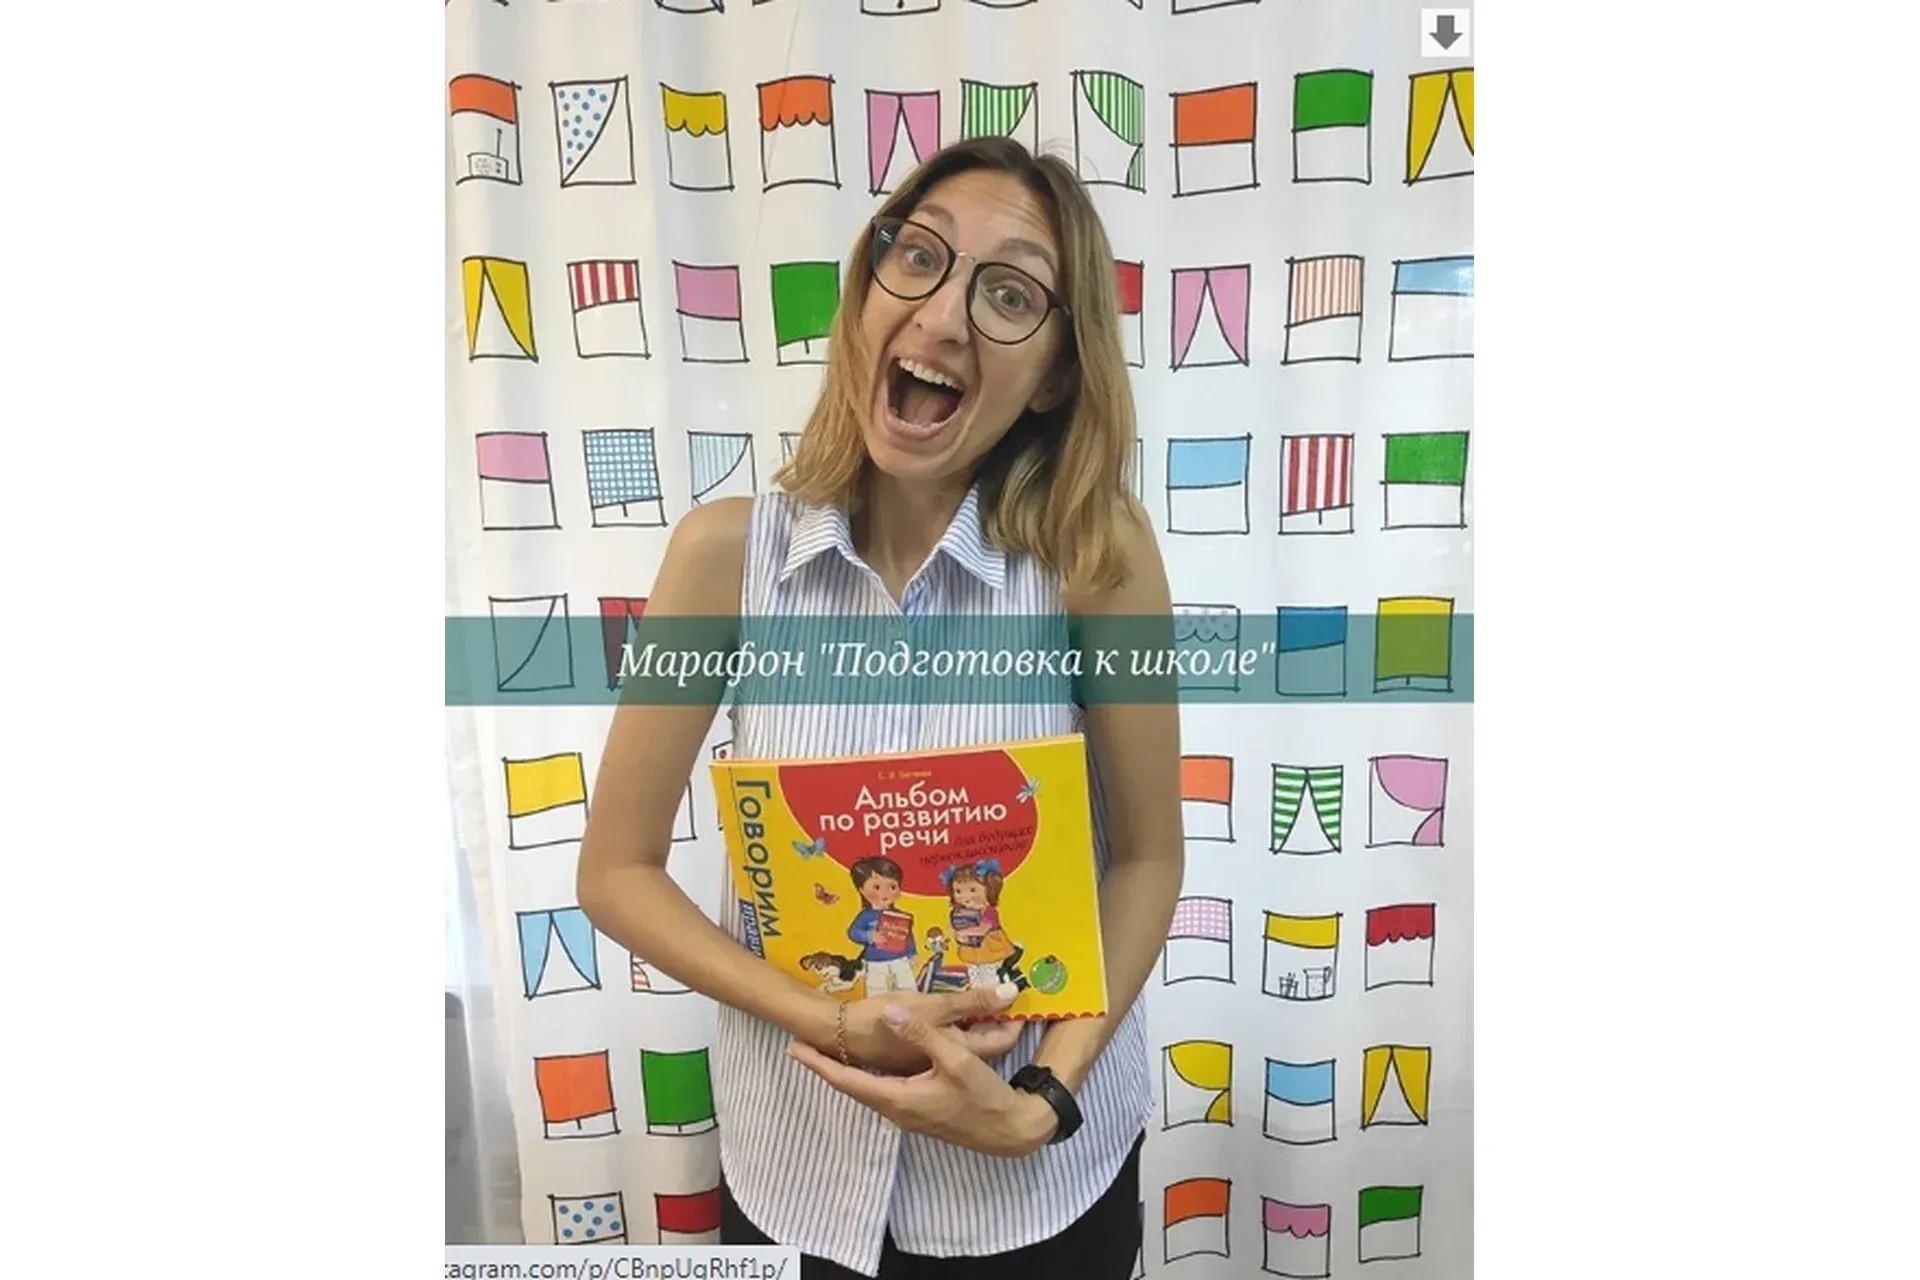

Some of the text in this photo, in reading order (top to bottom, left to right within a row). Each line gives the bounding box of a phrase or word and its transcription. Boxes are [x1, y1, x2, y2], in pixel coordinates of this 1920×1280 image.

[855, 780, 968, 810] Альбом
[819, 804, 1007, 836] по развитию
[880, 828, 949, 855] речи
[736, 780, 782, 936] Говорим
